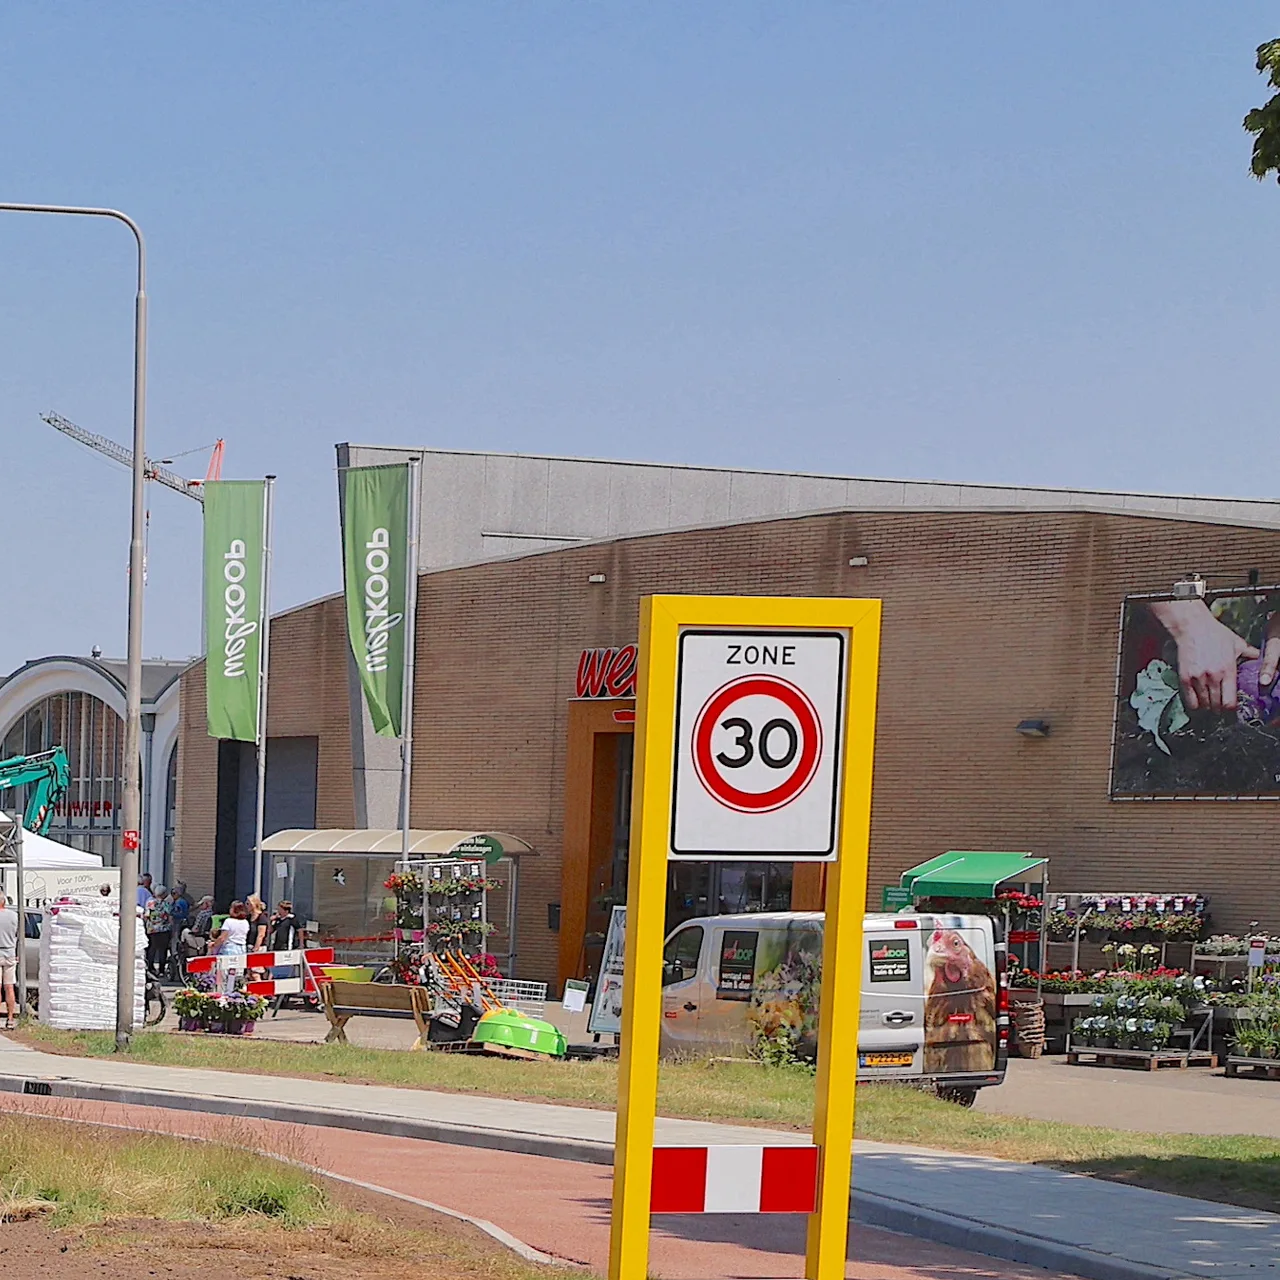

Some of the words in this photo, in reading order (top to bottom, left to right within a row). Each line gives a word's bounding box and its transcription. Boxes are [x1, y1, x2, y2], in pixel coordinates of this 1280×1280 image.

[726, 645, 796, 665] ZONE
[716, 717, 798, 769] 30
[57, 877, 73, 885] Voor
[74, 874, 94, 883] 100%
